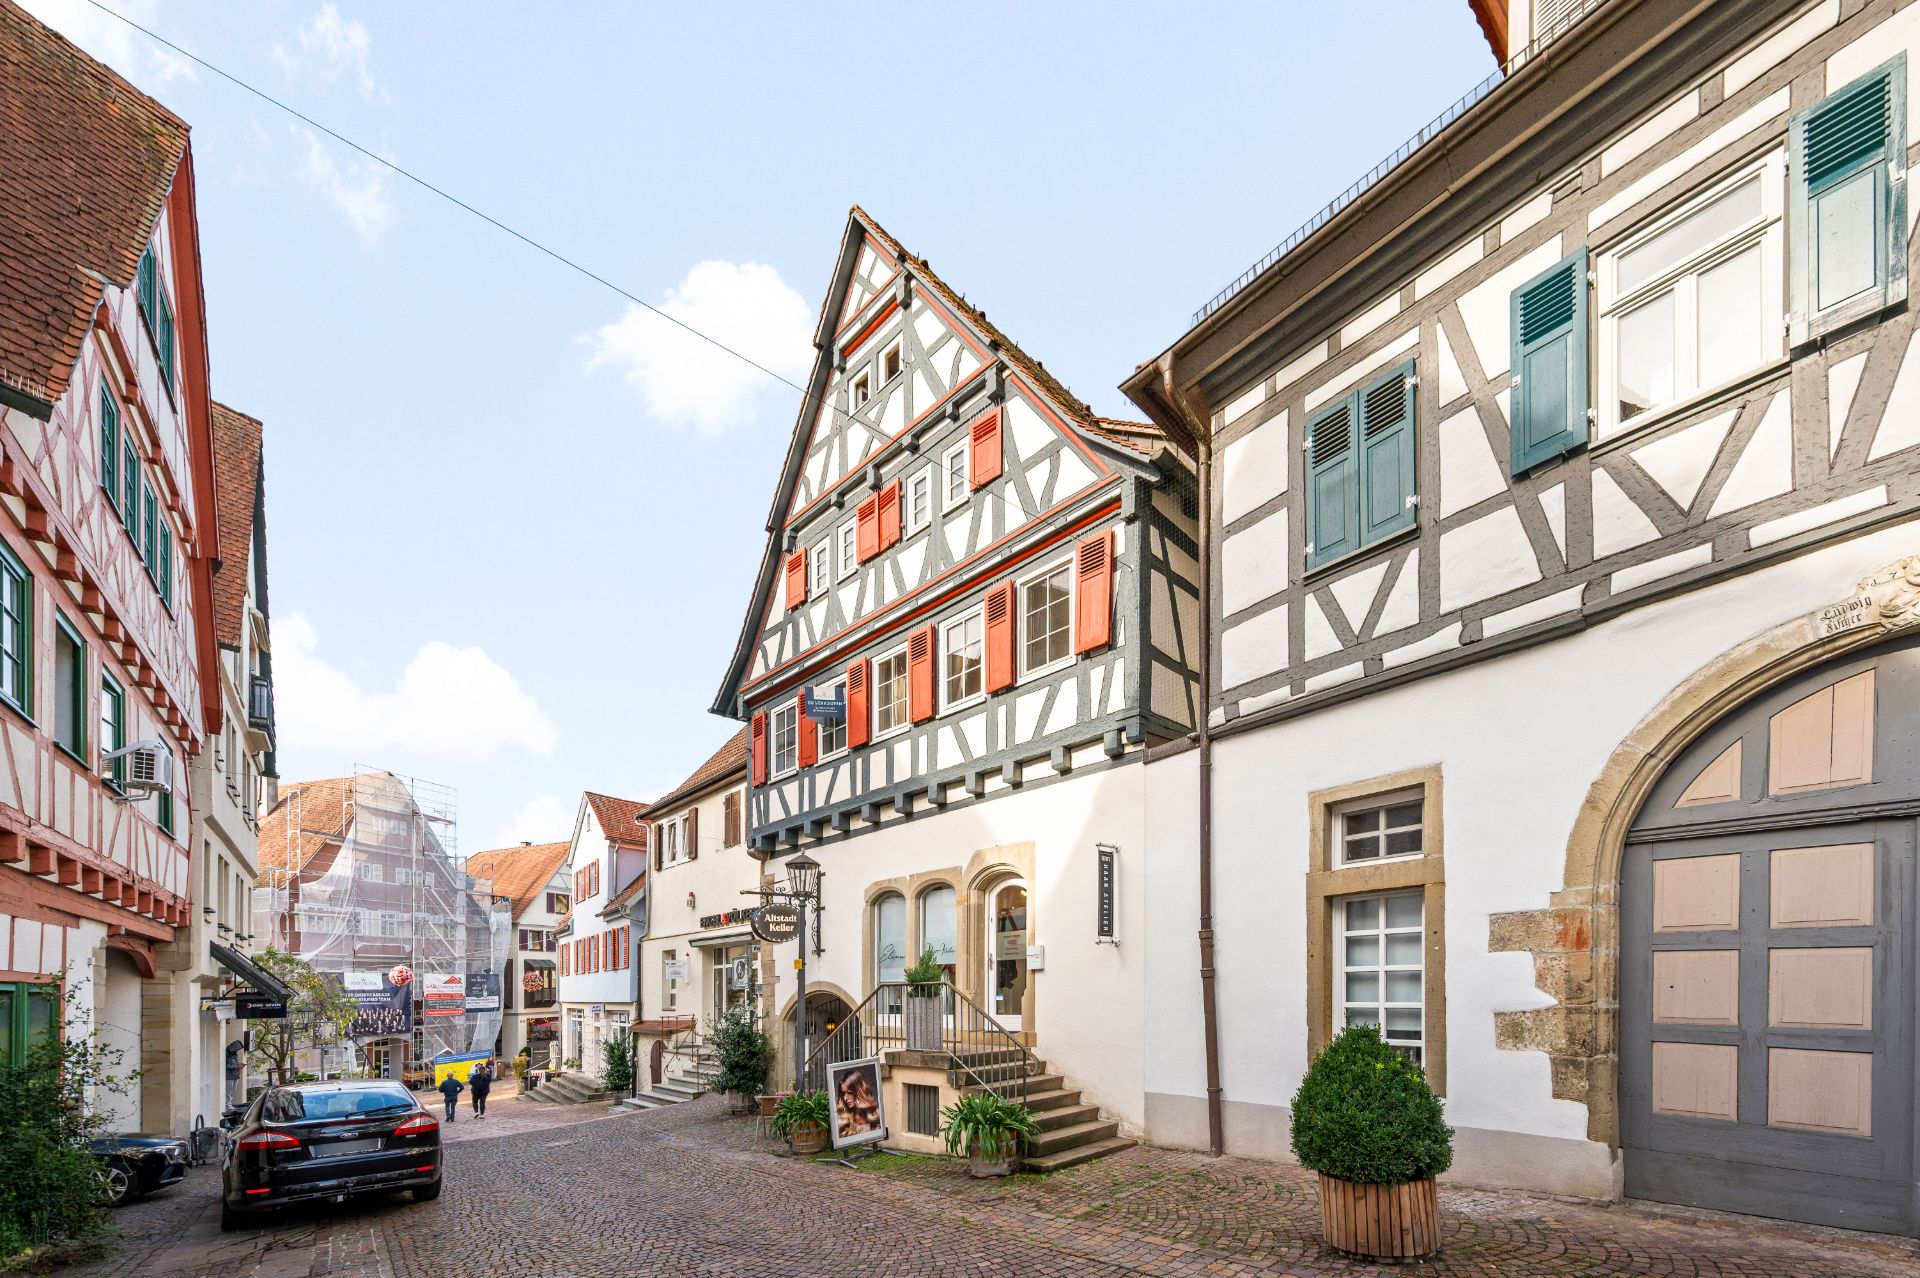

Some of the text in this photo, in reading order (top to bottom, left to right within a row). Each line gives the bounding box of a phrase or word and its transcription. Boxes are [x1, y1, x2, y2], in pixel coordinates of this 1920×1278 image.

[764, 913, 797, 923] Altstadt
[769, 923, 794, 932] Keller
[879, 944, 905, 964] Elena
